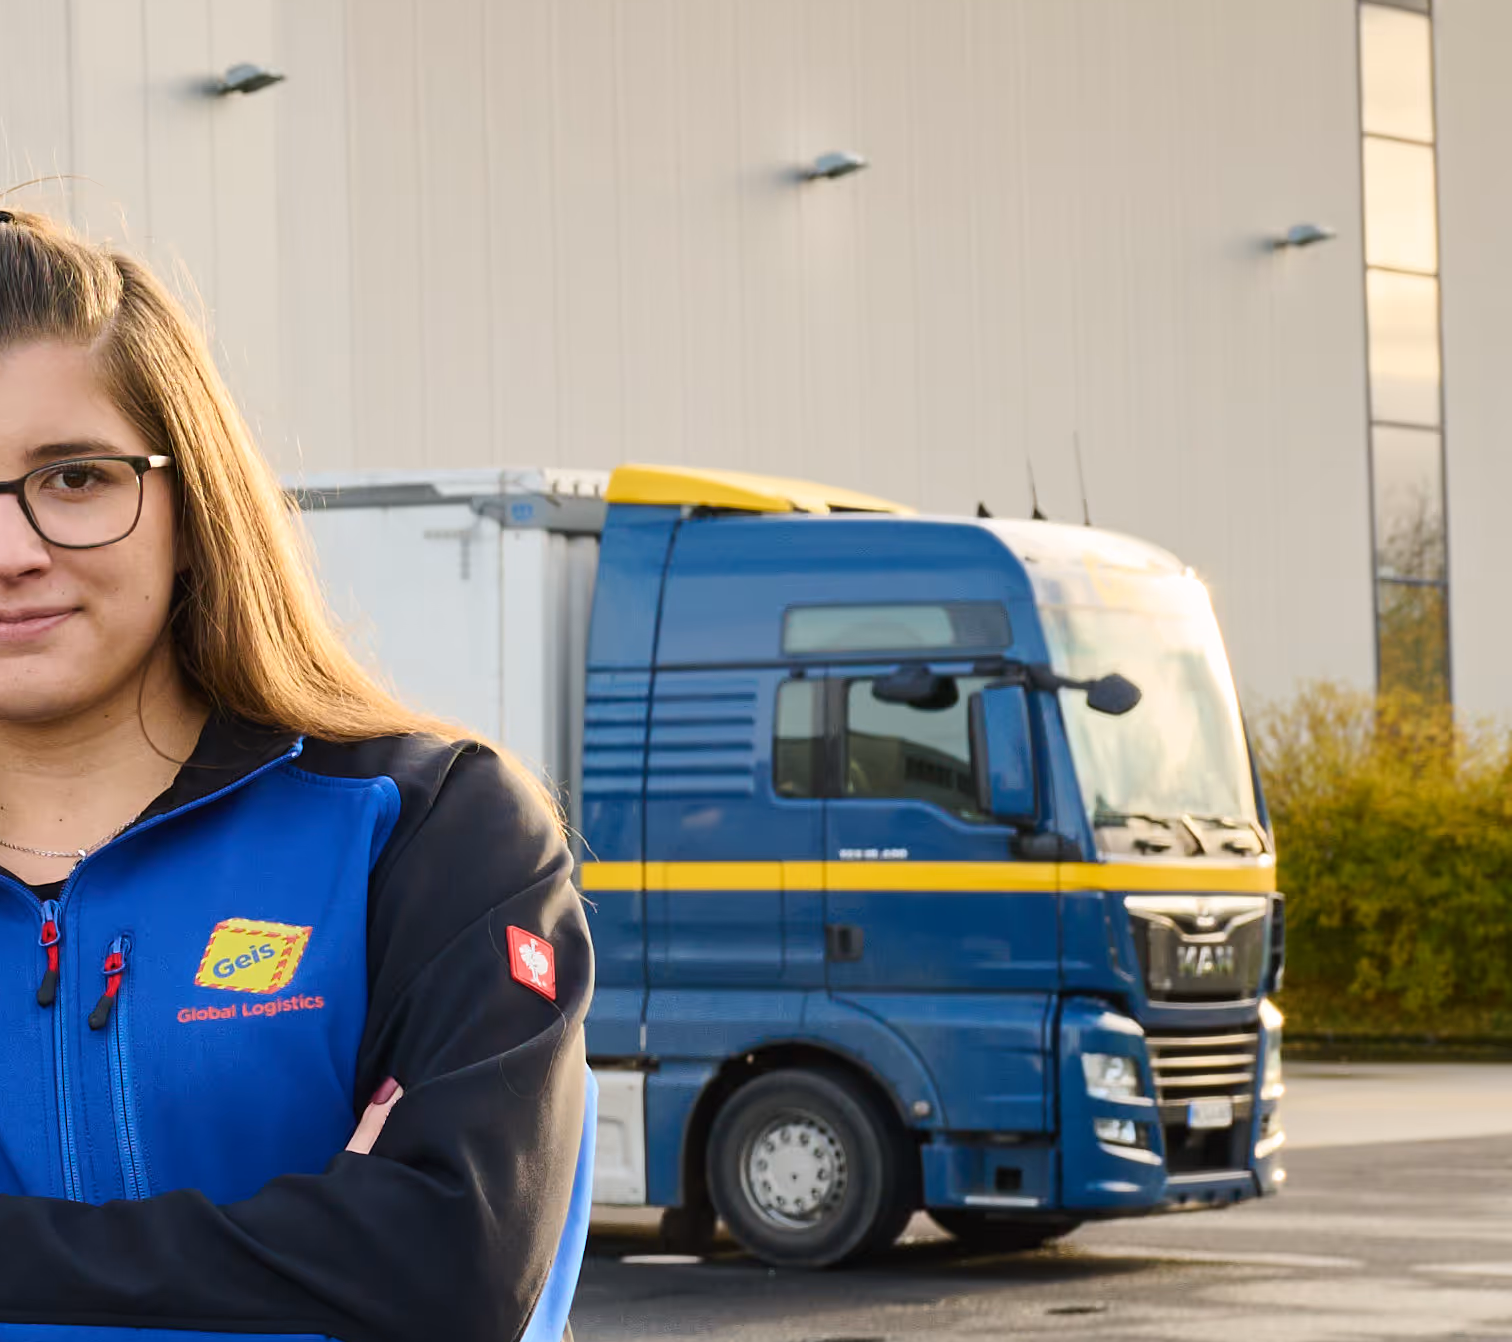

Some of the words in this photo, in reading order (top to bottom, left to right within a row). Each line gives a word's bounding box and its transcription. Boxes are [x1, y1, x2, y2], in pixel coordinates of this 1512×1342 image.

[213, 943, 276, 979] Geis
[1177, 945, 1234, 978] MAN
[177, 1004, 237, 1023] Global
[241, 994, 325, 1017] Logistics
